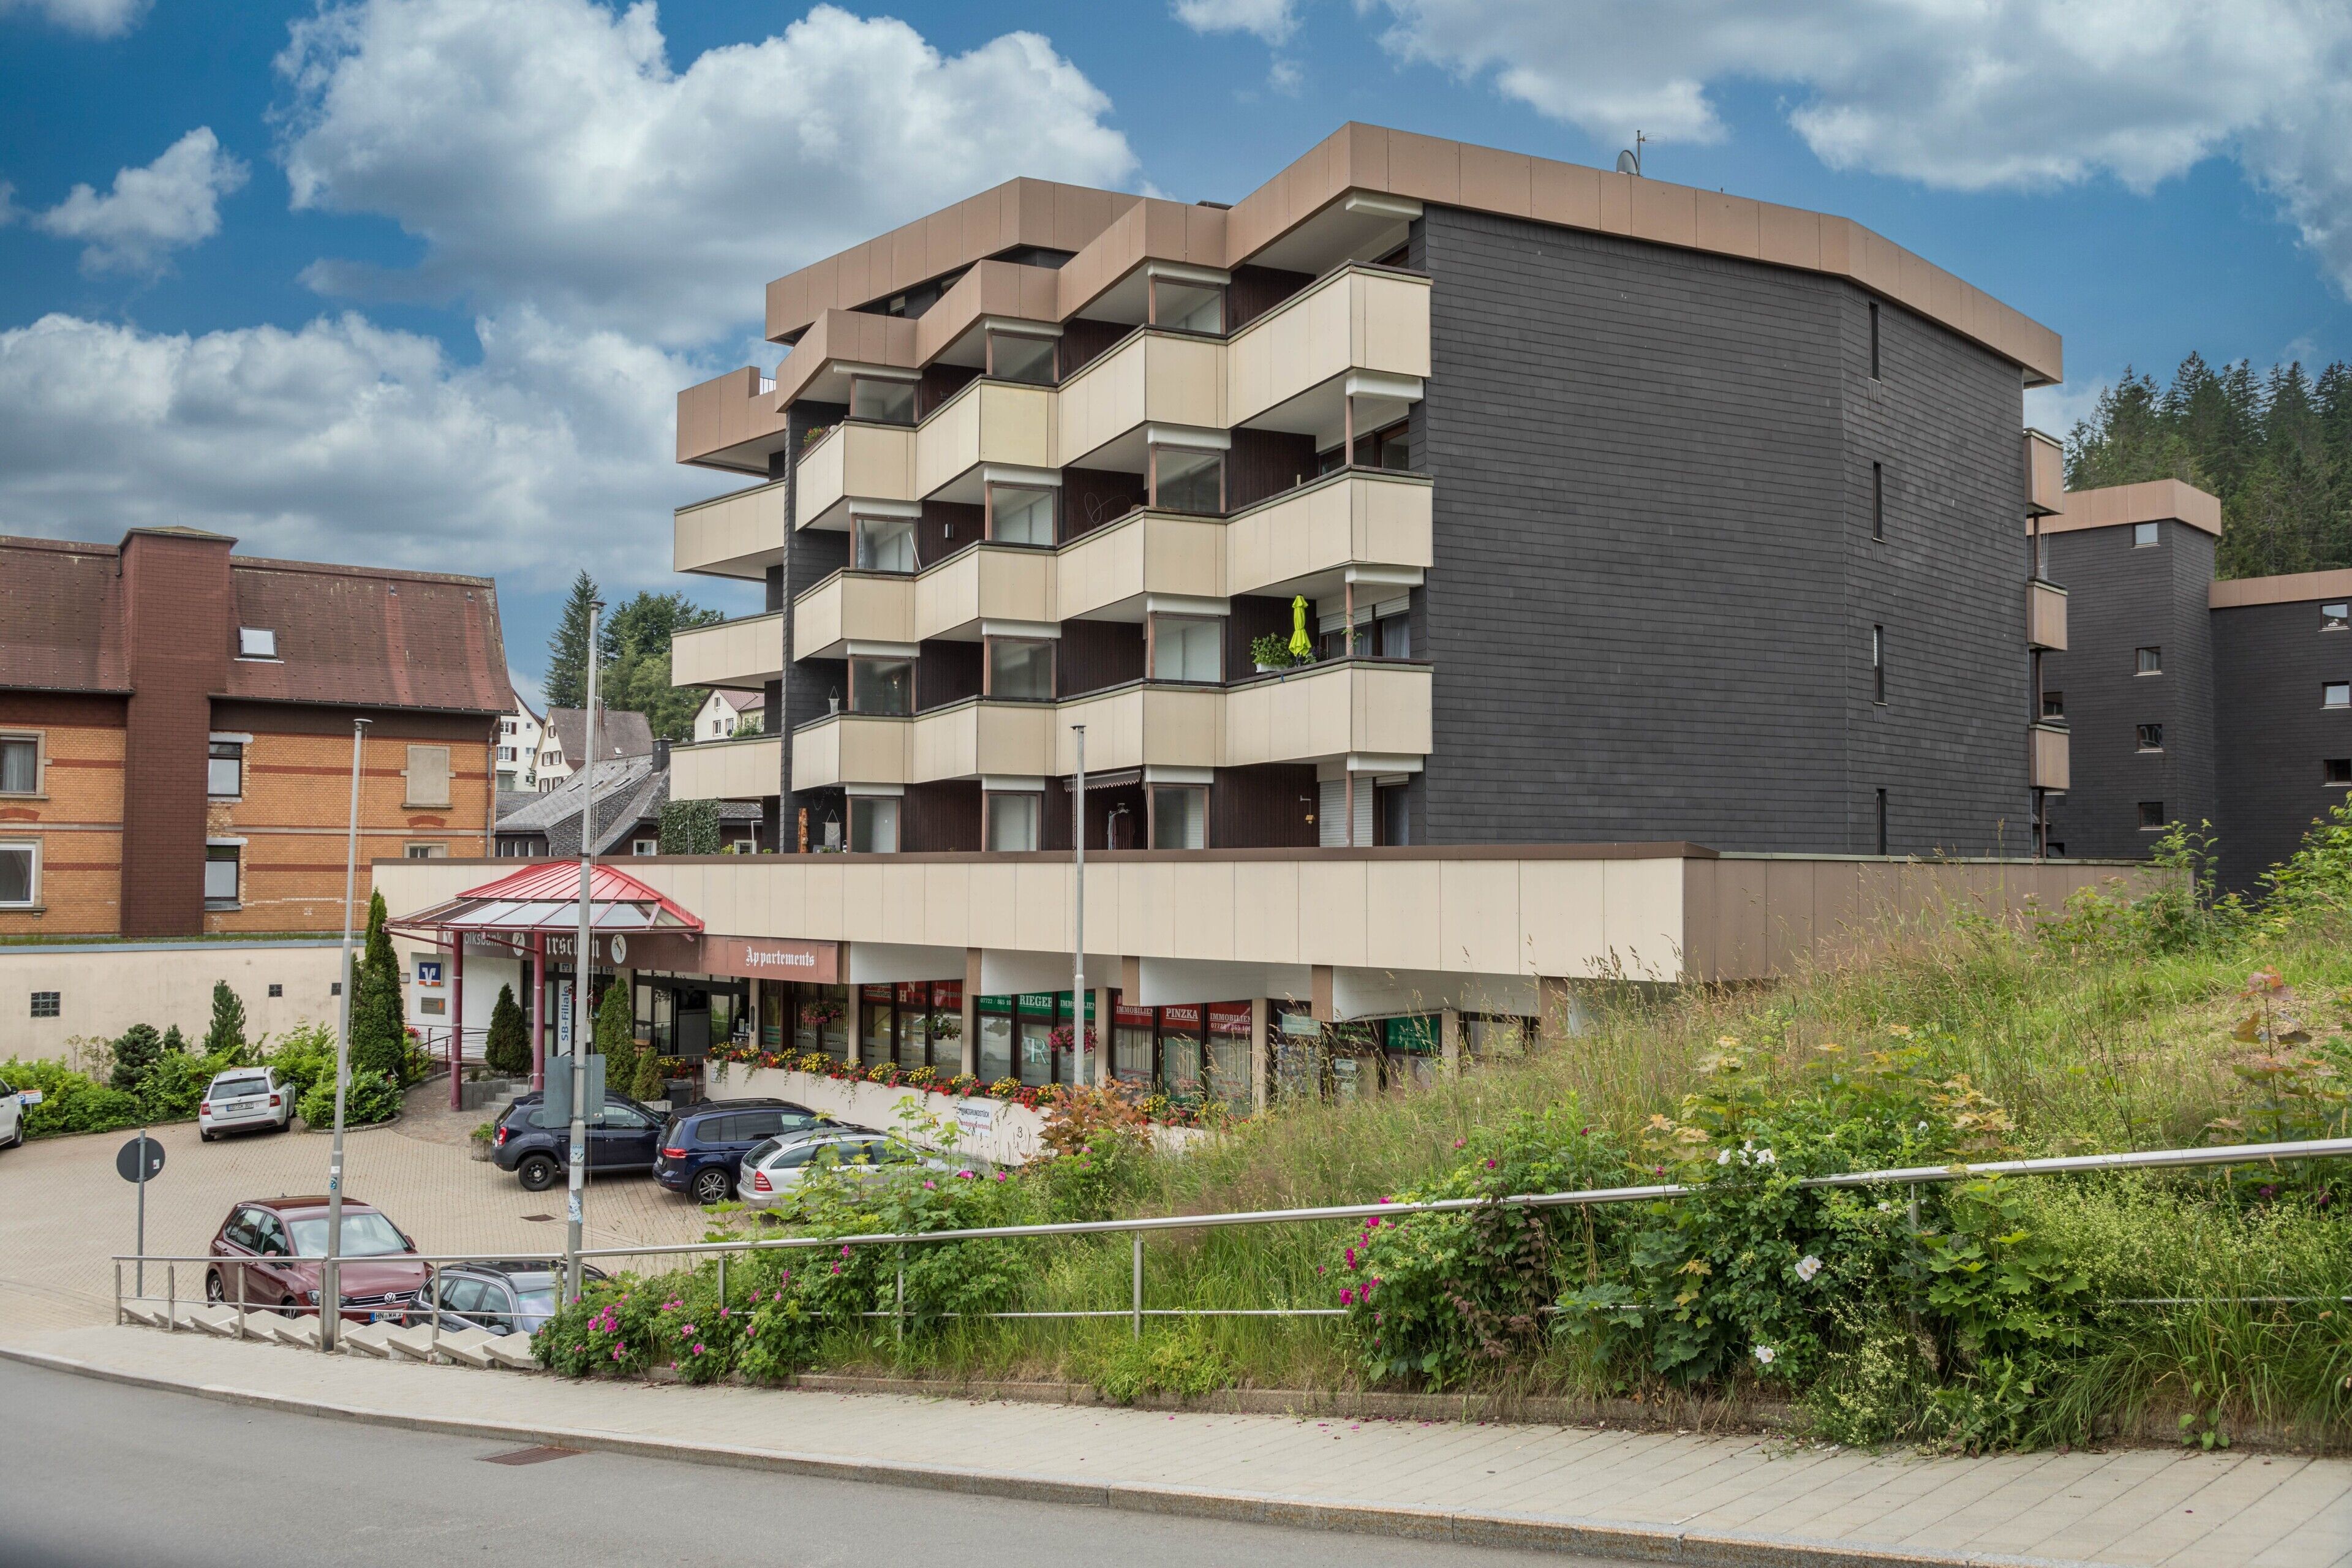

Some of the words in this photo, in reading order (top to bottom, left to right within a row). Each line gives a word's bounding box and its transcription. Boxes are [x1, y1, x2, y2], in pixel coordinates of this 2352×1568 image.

[462, 931, 502, 947] olksbank
[745, 946, 815, 967] Appartements
[561, 986, 570, 1041] SB-Filiale
[1166, 1008, 1198, 1019] PINZKA
[1017, 1126, 1023, 1138] 3
